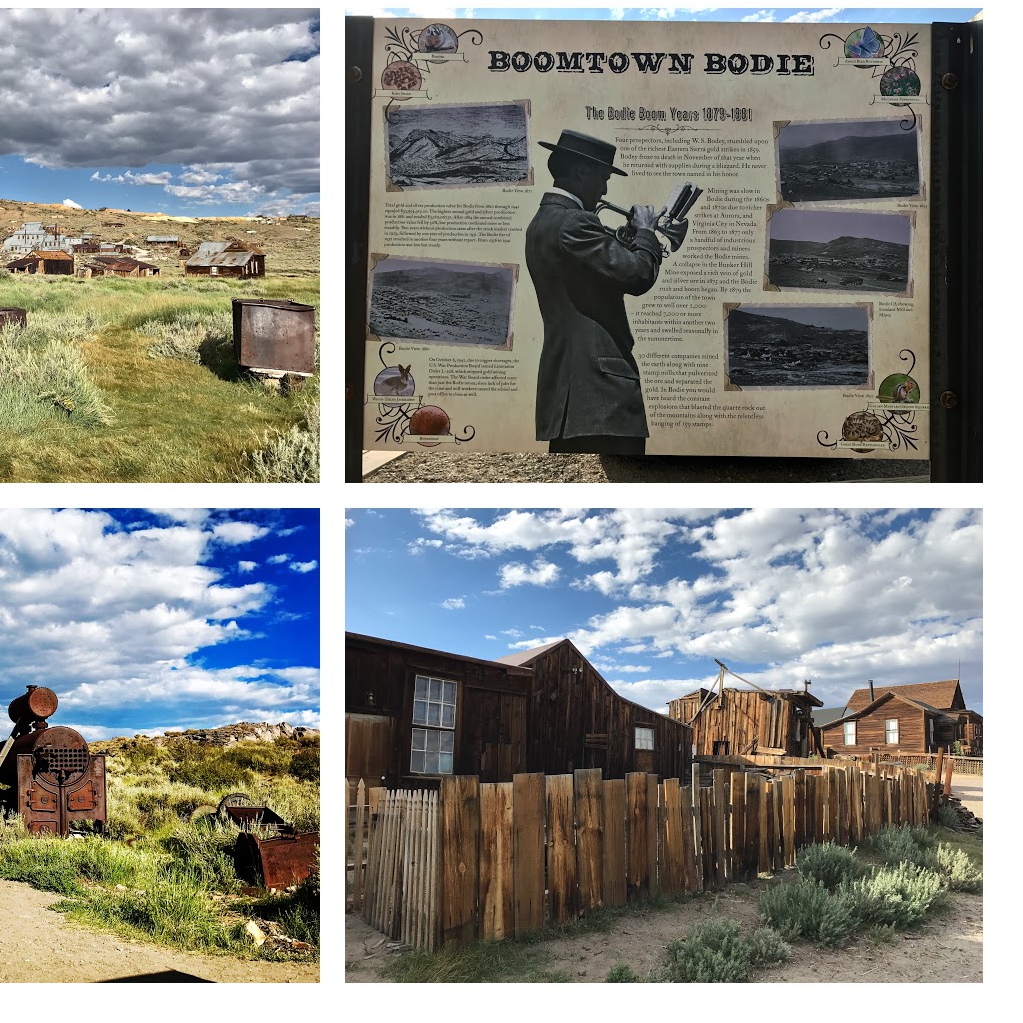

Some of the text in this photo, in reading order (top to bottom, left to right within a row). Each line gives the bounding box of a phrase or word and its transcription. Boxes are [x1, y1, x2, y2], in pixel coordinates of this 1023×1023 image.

[487, 51, 814, 76] BOOMTOWN BODIE
[585, 106, 753, 122] The Bodie Boom Years 1879-1881
[630, 137, 663, 145] prospectors,
[664, 137, 690, 145] including
[707, 137, 726, 146] Bodey,
[707, 145, 719, 154] gold
[620, 153, 637, 161] Bodey
[669, 161, 691, 170] supplies
[692, 162, 711, 170] during
[708, 187, 728, 195] Mining
[724, 195, 743, 203] during
[720, 212, 741, 220] Aurora,
[693, 220, 714, 228] Virginia
[716, 220, 727, 228] City
[679, 261, 701, 269] collapse
[680, 269, 702, 277] exposed
[740, 269, 752, 278] gold
[671, 353, 700, 361] companies
[667, 361, 682, 369] along
[643, 369, 660, 377] stamp
[688, 369, 718, 377] pulverized
[675, 378, 702, 386] separated
[645, 386, 659, 394] gold.
[649, 403, 678, 411] explosions
[697, 412, 712, 420] along
[651, 420, 673, 428] banging
[692, 420, 713, 428] stamps.
